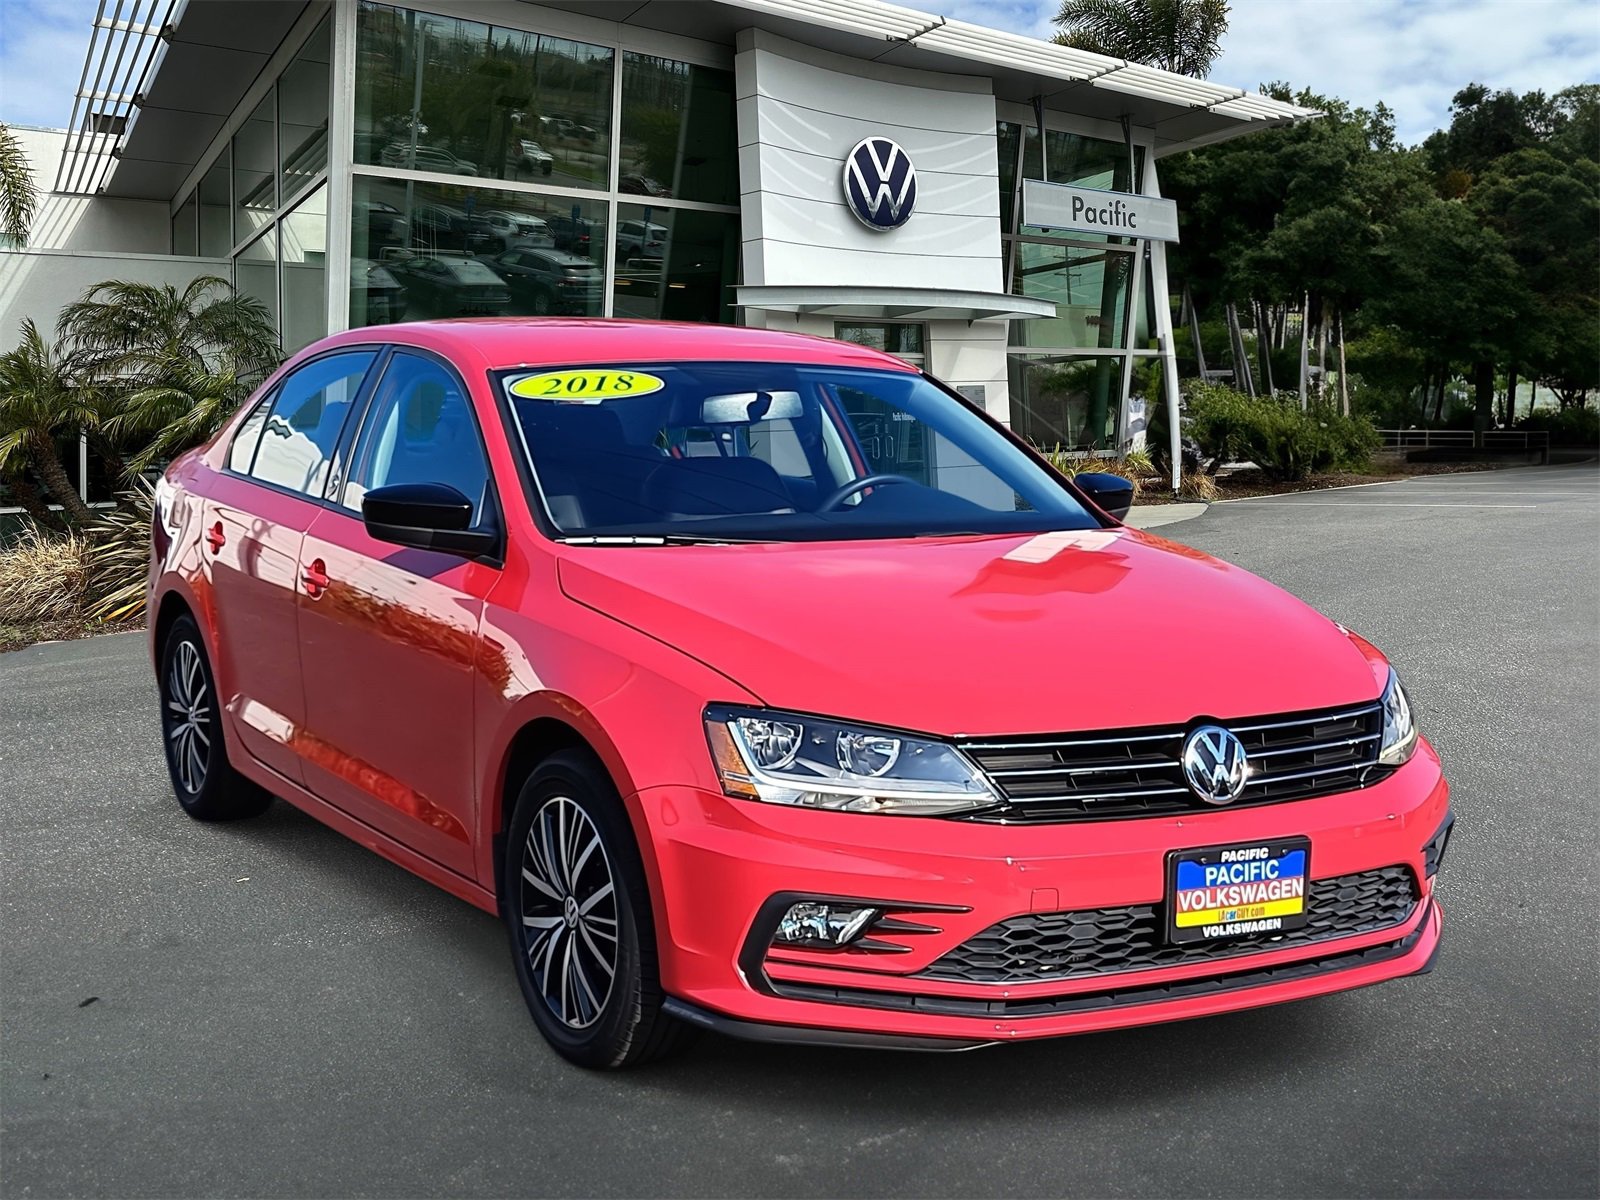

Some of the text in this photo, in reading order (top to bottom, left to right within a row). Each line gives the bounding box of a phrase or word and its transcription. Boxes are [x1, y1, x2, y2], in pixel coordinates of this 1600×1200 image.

[845, 138, 918, 230] VW
[1071, 195, 1137, 229] Pacific
[540, 374, 635, 396] 2018
[1183, 726, 1247, 804] VW
[1221, 847, 1269, 863] PACIFIC
[1205, 859, 1280, 886] PACIFIC
[1178, 877, 1304, 912] VOLKSWAGEN
[1202, 917, 1282, 938] VOLKSWAGEN
